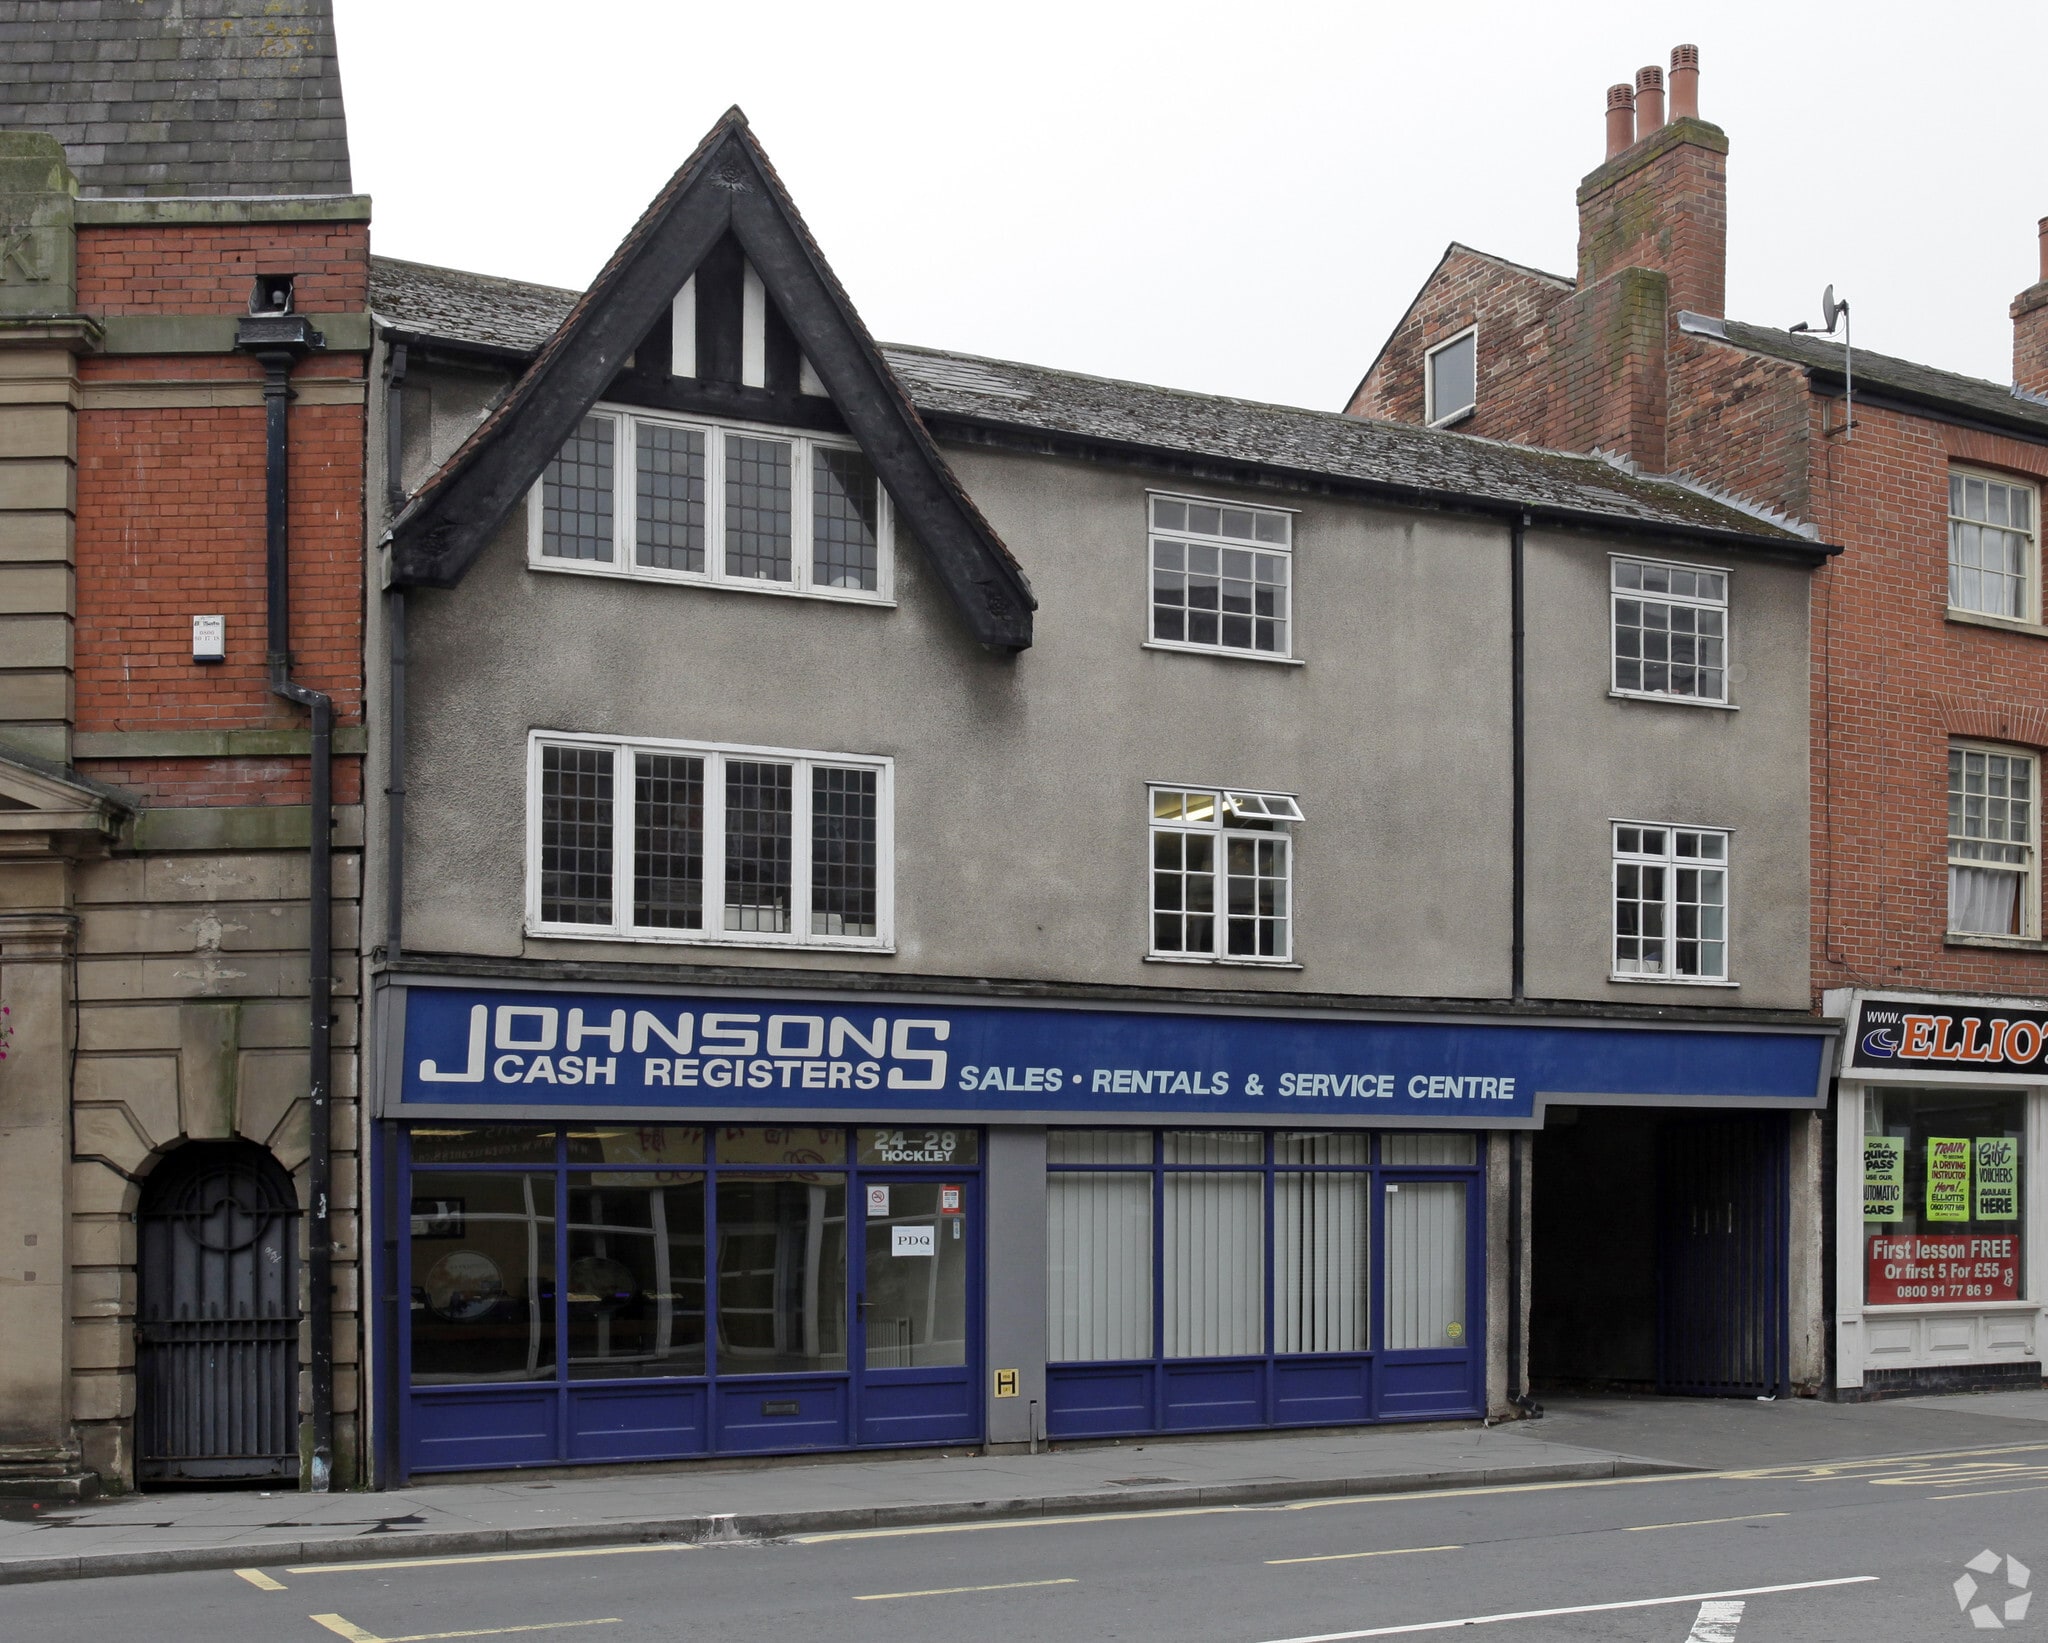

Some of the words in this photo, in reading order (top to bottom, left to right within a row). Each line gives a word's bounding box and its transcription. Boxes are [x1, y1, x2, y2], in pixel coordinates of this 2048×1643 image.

[1898, 1014, 2048, 1065] ELLIO
[418, 1004, 951, 1090] JOHNSONS
[493, 1054, 616, 1085] CASH
[644, 1058, 880, 1089] REGISTERS
[958, 1065, 1063, 1092] SALES
[1091, 1069, 1229, 1095] RENTALS
[1244, 1072, 1264, 1096] &
[1277, 1072, 1394, 1098] SERVICE
[1407, 1074, 1515, 1100] CENTRE
[881, 1150, 953, 1161] HOCKLEY
[1864, 1150, 1898, 1161] QUICK
[1934, 1142, 1966, 1156] TRAIN
[1978, 1141, 2011, 1167] Gift
[1865, 1160, 1894, 1171] PASS
[1932, 1160, 1938, 1169] A
[1939, 1161, 1966, 1169] DRIVING
[1932, 1171, 1966, 1180] INSTRUCTOR
[1979, 1168, 2013, 1183] VOUCHERS
[1931, 1193, 1965, 1202] ELLIOTTS
[1980, 1188, 2011, 1196] AVAILABLE
[1863, 1205, 1894, 1215] CARS
[1980, 1198, 2012, 1214] HERE
[897, 1236, 930, 1245] PDQ
[1873, 1239, 1911, 1259] First
[1916, 1239, 1965, 1259] lesson
[1970, 1239, 2011, 1258] FREE
[1884, 1263, 1902, 1279] Or
[1905, 1263, 1935, 1279] first
[1938, 1263, 1946, 1278] 5
[1950, 1263, 1971, 1278] For
[1974, 1262, 1999, 1278] £55
[1897, 1285, 1927, 1298] 0800
[1931, 1285, 1945, 1297] 91
[1949, 1284, 1963, 1297] 77
[1966, 1284, 1981, 1296] 86
[1985, 1284, 1993, 1296] 9
